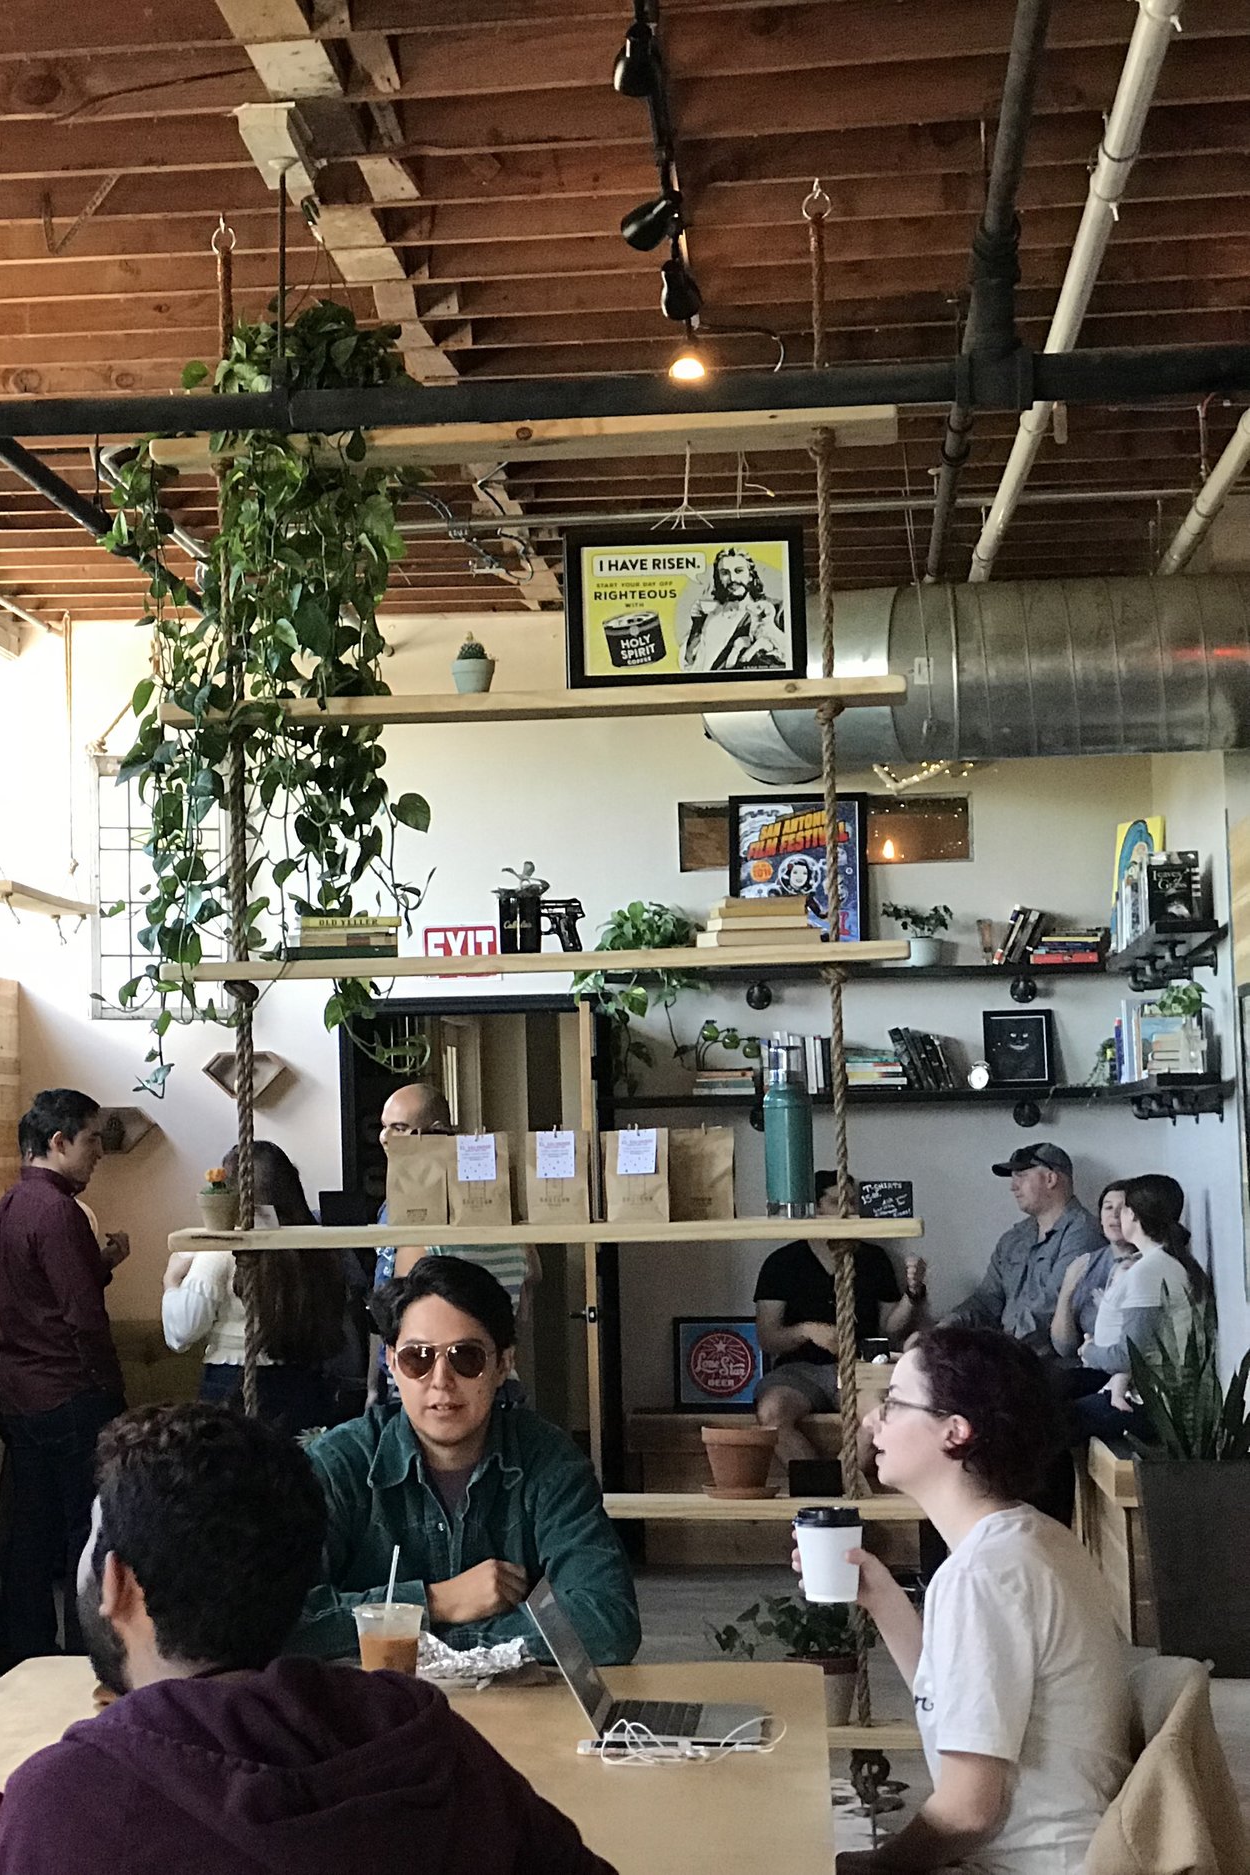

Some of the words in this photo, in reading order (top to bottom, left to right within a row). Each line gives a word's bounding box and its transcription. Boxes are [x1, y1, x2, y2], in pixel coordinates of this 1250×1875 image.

[599, 560, 604, 572] I
[608, 559, 648, 571] HAVE
[652, 557, 701, 570] RISEN.
[594, 589, 677, 601] RIGHTEOUS
[620, 633, 651, 649] HOLY
[620, 643, 656, 660] SPIRIT
[627, 656, 652, 666] COFFEE
[760, 821, 782, 841] SAN
[783, 812, 828, 835] ANTONI
[747, 837, 779, 860] FILM
[427, 930, 494, 957] EXIT
[707, 1379, 735, 1387] BEER
